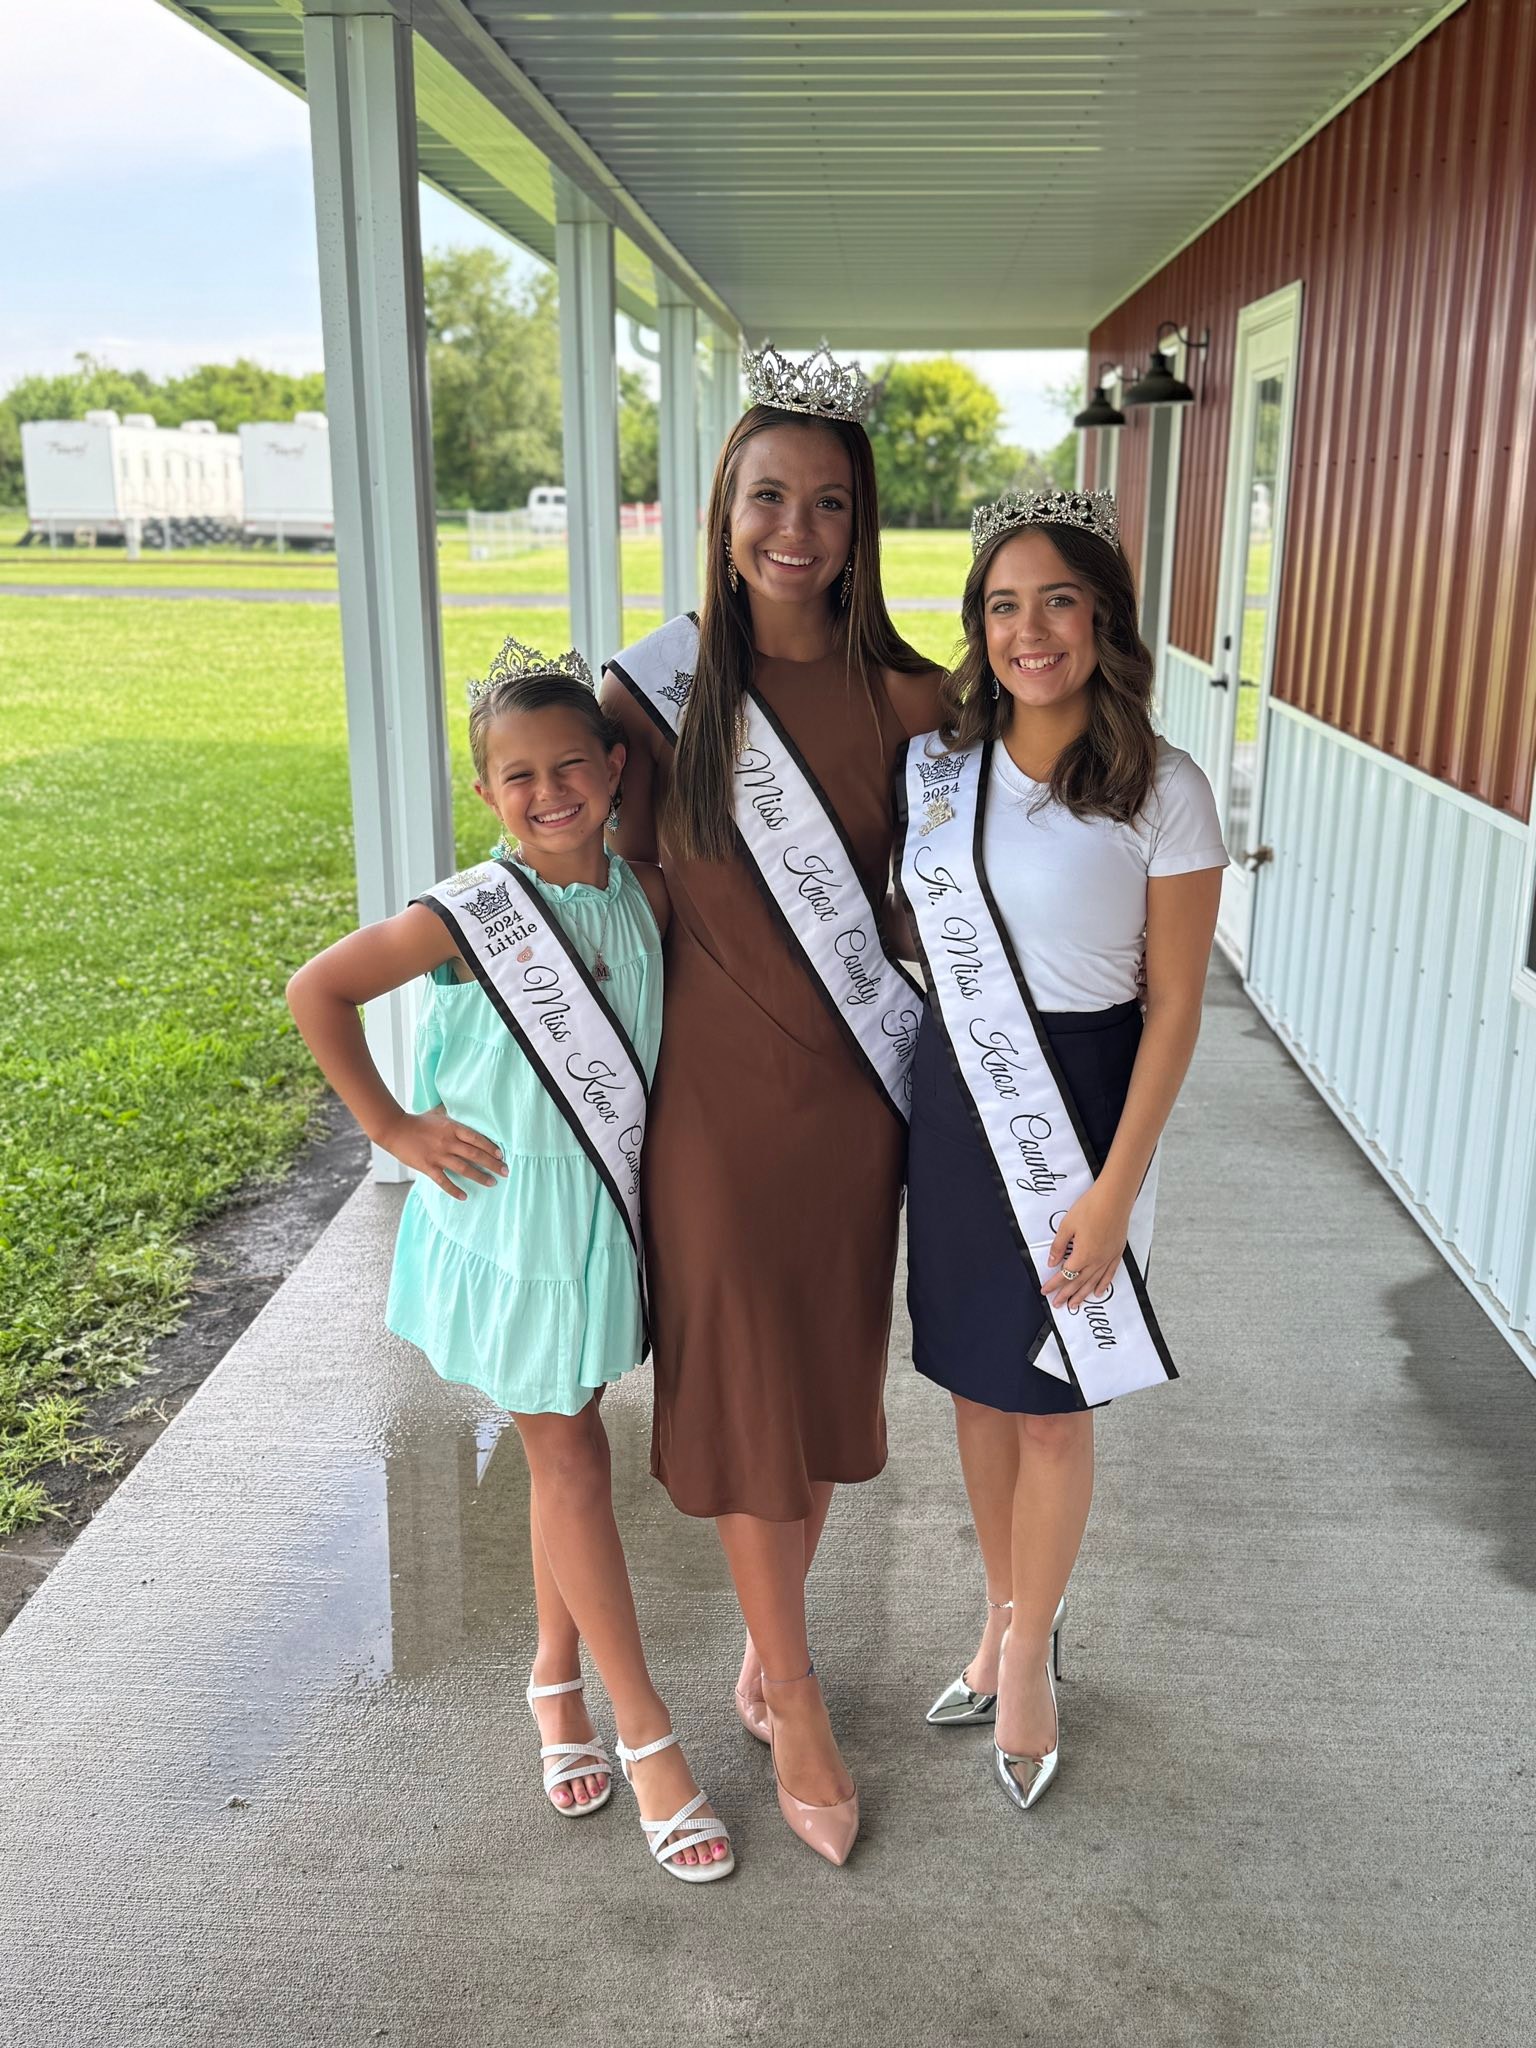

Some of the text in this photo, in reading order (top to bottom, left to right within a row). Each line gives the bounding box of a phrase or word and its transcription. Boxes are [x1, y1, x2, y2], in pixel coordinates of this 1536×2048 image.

[923, 782, 960, 804] 2024
[484, 910, 525, 939] 2024
[734, 748, 788, 831] Miss
[783, 846, 844, 922] Knox
[834, 923, 877, 1005] County
[485, 922, 538, 958] Little
[523, 965, 572, 1043] Miss
[565, 1052, 627, 1124] Knox
[941, 916, 984, 1001] Miss
[969, 1018, 1028, 1100] Knox
[1009, 1112, 1068, 1197] County
